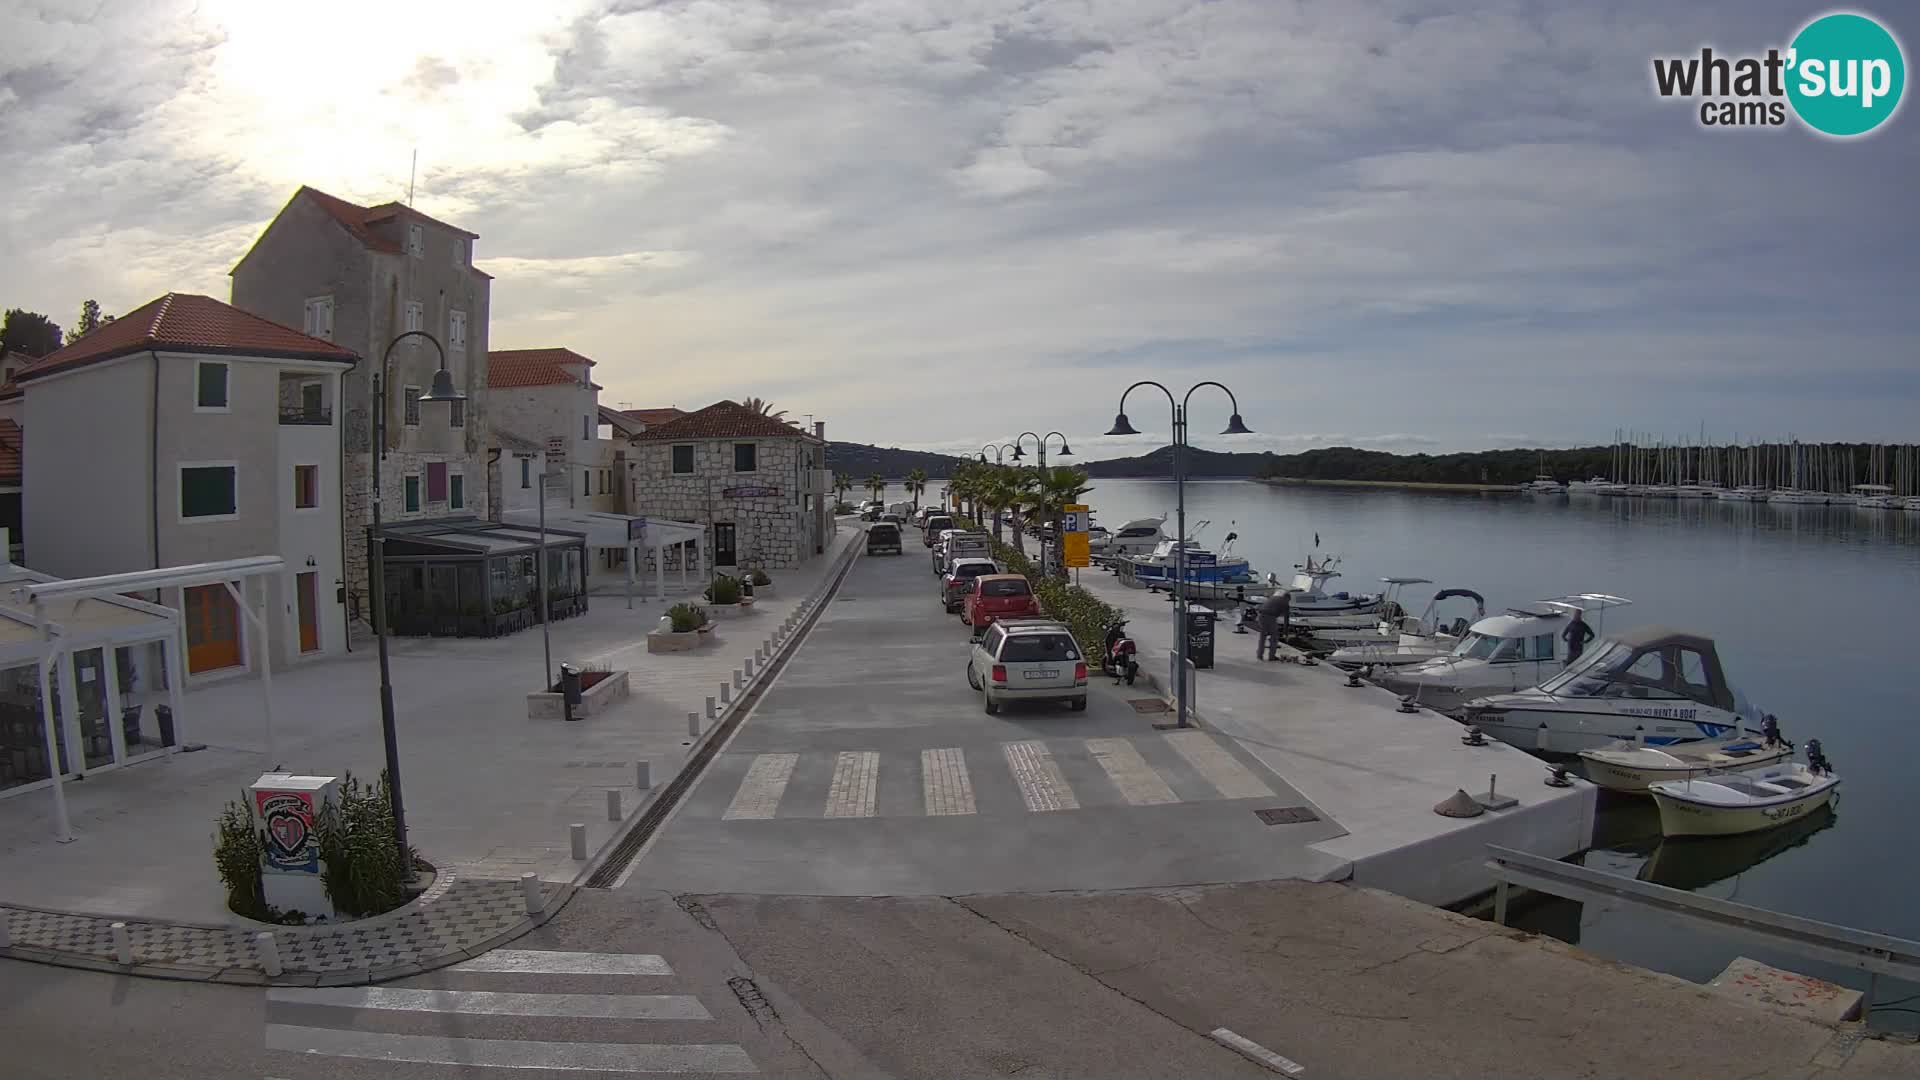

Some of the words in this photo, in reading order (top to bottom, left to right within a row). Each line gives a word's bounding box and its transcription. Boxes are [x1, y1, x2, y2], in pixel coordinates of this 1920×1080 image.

[1066, 514, 1077, 531] P
[1653, 708, 1673, 717] RENT
[1680, 708, 1697, 720] BOAT
